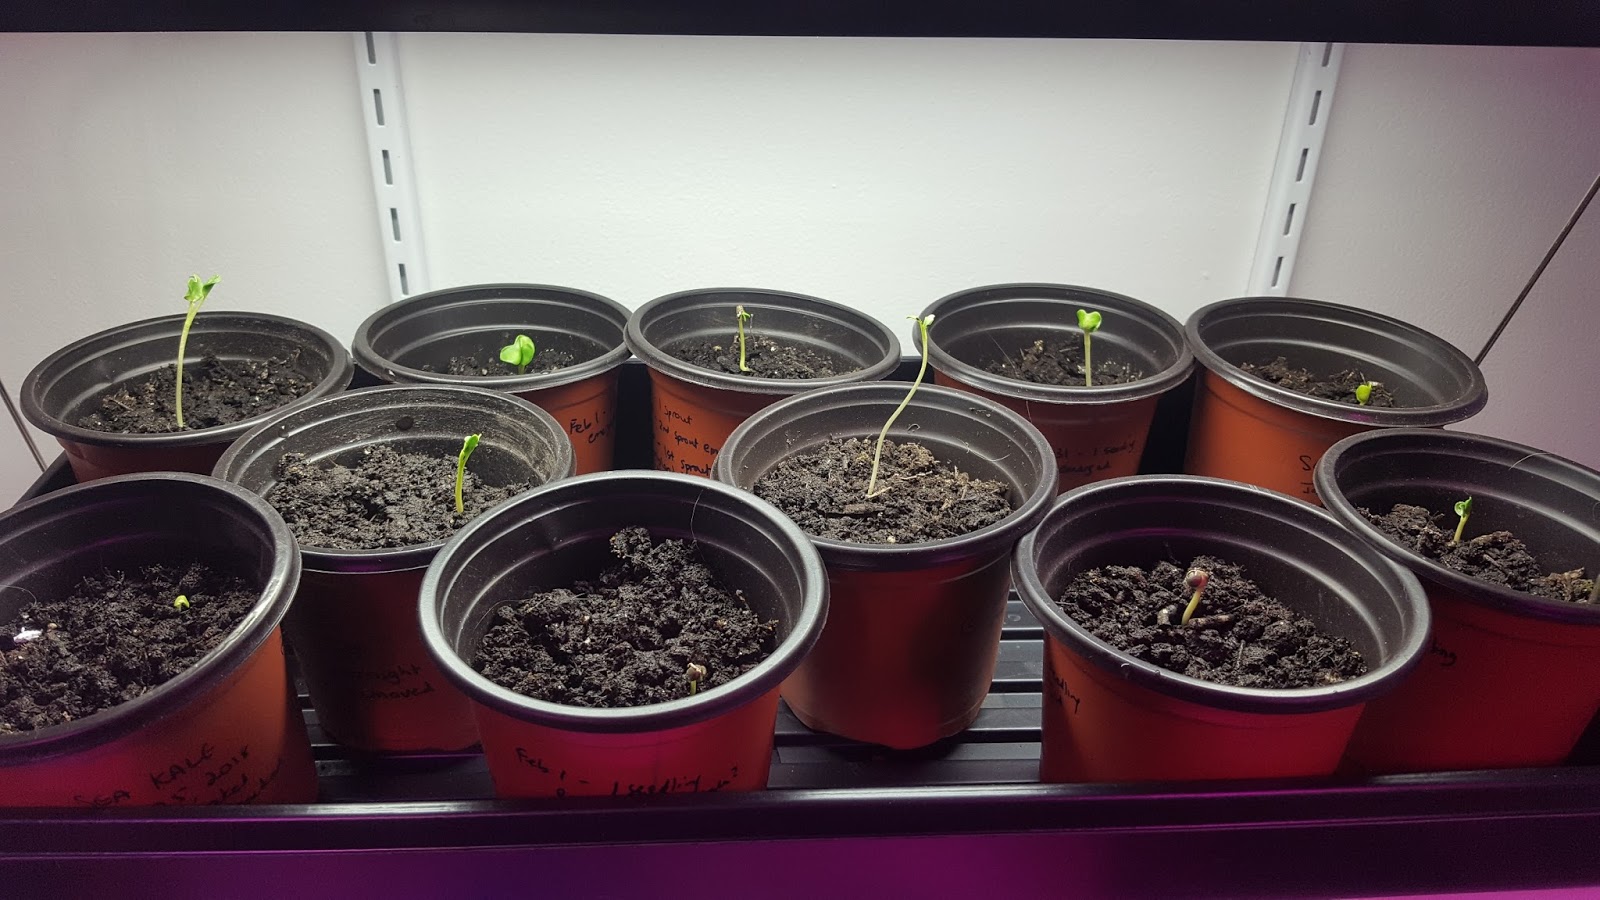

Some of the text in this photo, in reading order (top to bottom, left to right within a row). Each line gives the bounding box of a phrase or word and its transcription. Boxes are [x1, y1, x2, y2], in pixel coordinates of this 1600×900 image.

[569, 418, 592, 435] Feb
[149, 742, 214, 791] KALE
[516, 747, 550, 773] Feb
